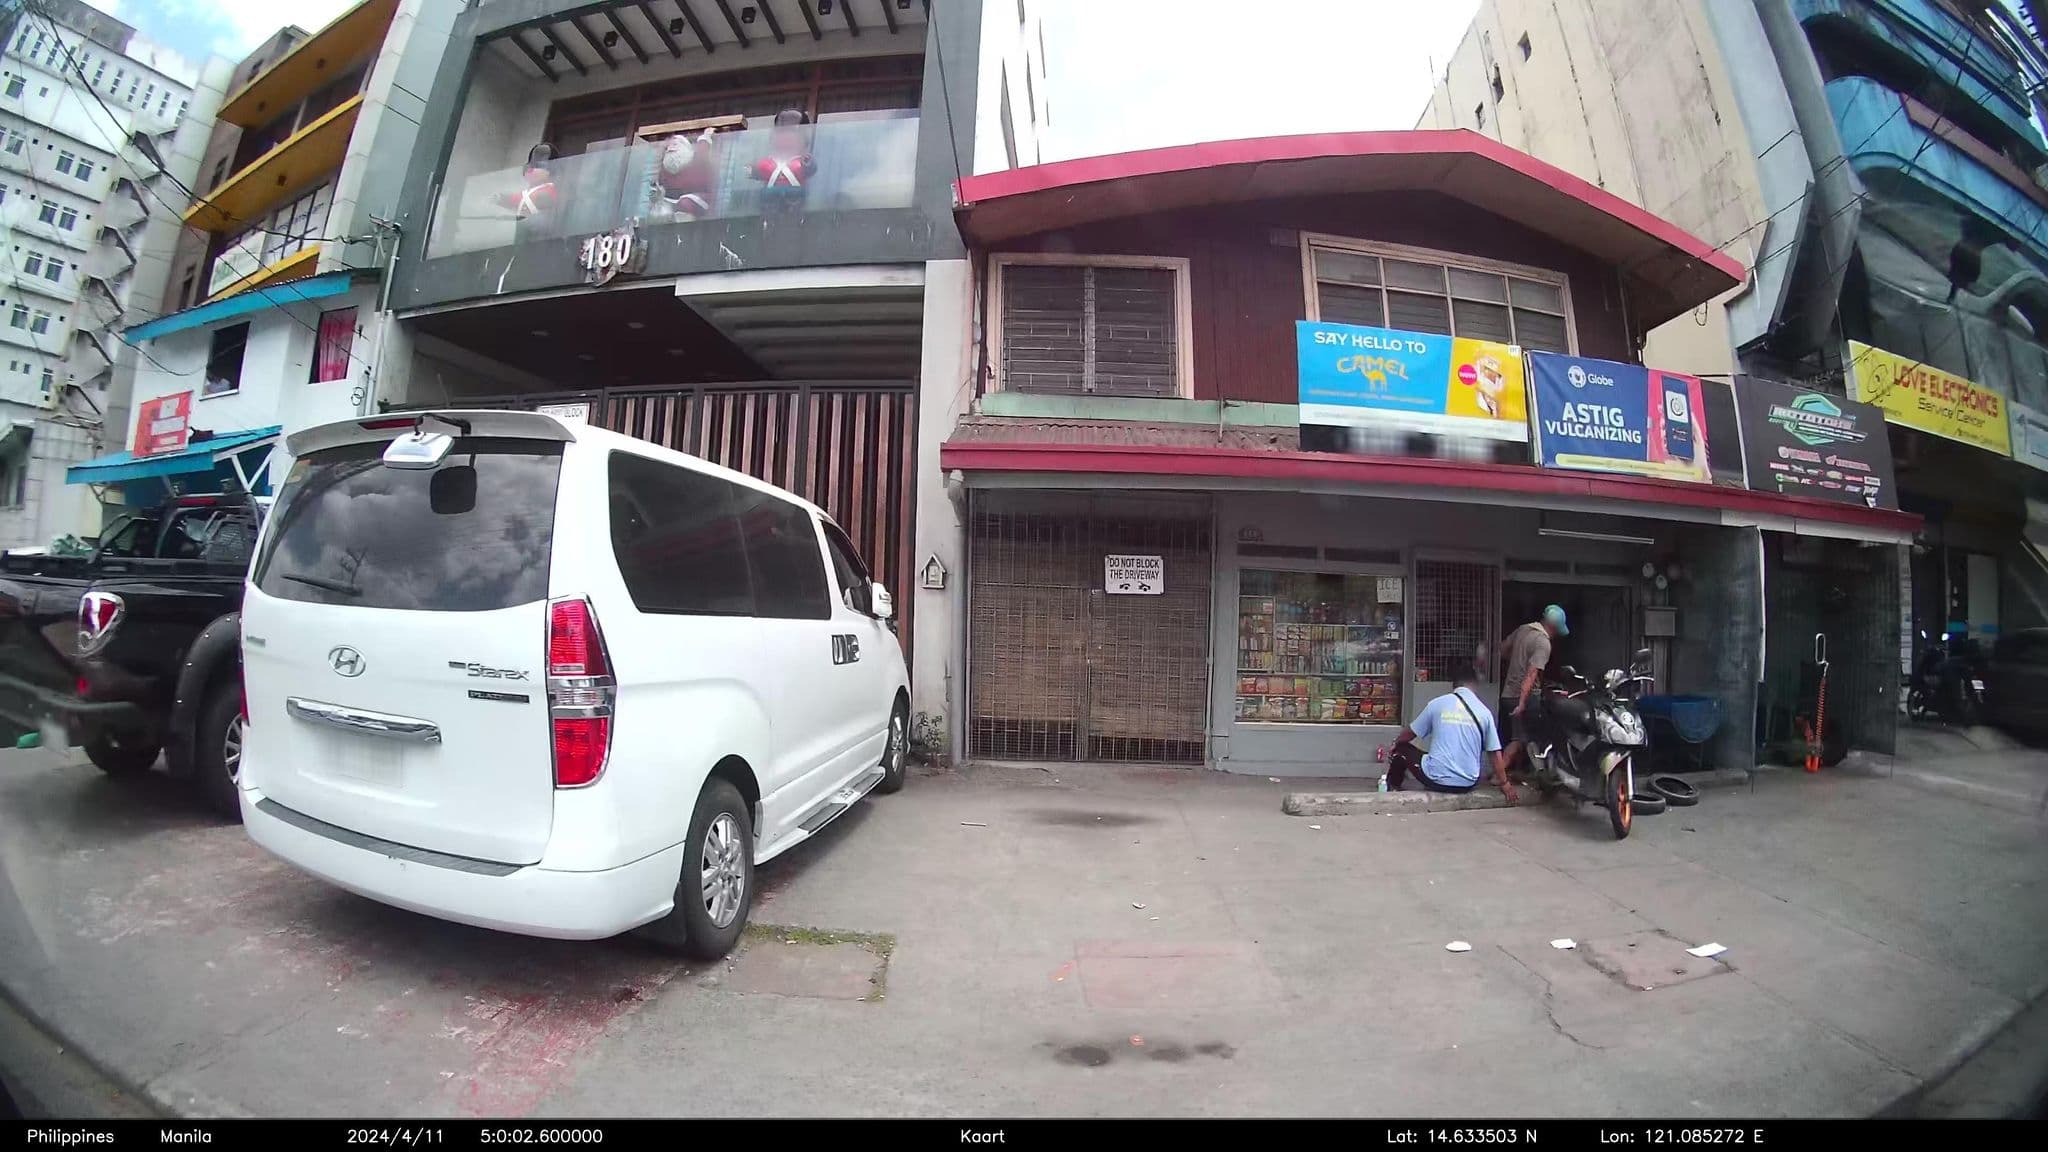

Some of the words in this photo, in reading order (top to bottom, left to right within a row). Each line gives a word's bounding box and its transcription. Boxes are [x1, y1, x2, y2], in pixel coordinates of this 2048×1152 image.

[586, 235, 631, 269] 180
[1314, 331, 1348, 346] SAY
[1352, 336, 1403, 351] HELLO
[1405, 341, 1426, 354] TO
[1336, 355, 1409, 380] CAMEL
[1587, 373, 1614, 387] Globe
[1893, 362, 1926, 394] LOVE
[1929, 374, 1999, 417] ELECTRONICS
[1562, 402, 1625, 428] ASTIG
[1918, 398, 1953, 420] Service
[1545, 420, 1642, 444] VULCANIZING
[1109, 558, 1119, 568] DO
[1121, 558, 1135, 568] NOT
[1136, 558, 1160, 569] BLOCK
[1110, 569, 1123, 580] THE
[1124, 569, 1160, 581] DRIVEWAY
[467, 662, 530, 681] Starex
